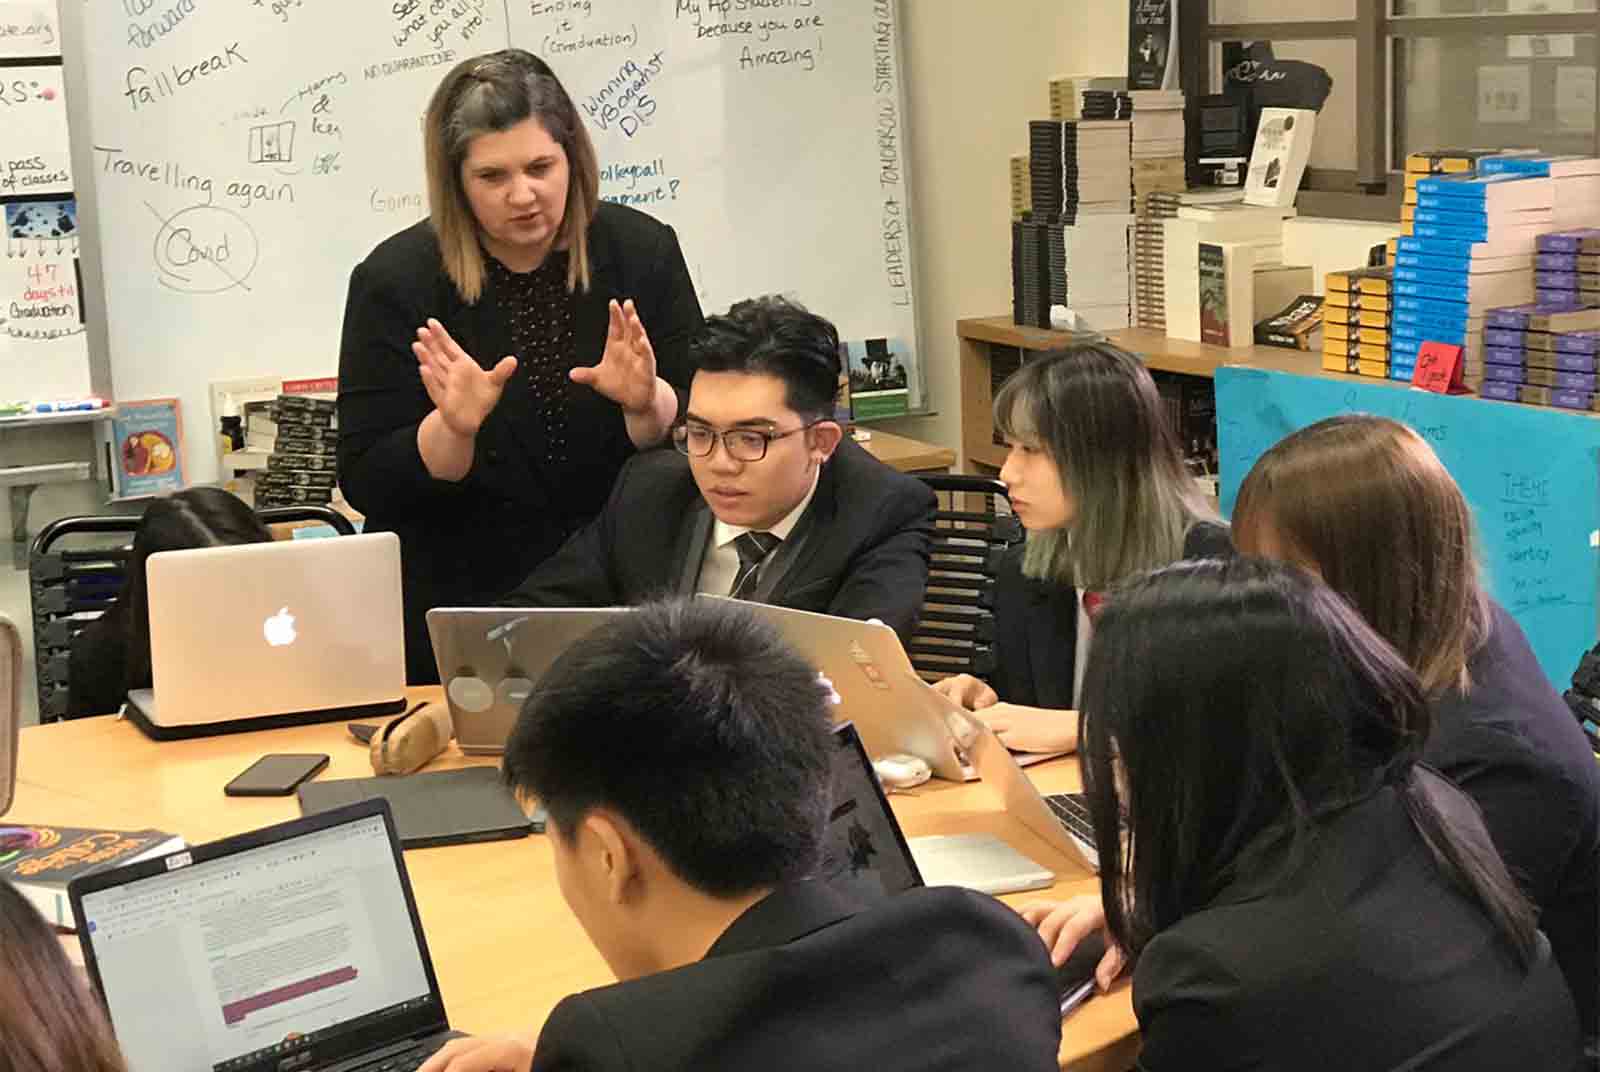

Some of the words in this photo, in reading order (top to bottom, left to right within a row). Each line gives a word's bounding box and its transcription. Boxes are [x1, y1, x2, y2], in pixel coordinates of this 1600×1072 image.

[696, 20, 753, 38] because
[758, 20, 788, 41] you
[794, 15, 824, 29] are
[739, 36, 823, 71] Amazing!
[9, 156, 46, 178] pass
[92, 144, 214, 207] Travelling
[226, 181, 295, 208] again
[2, 176, 17, 191] of
[22, 171, 69, 187] classes
[27, 264, 57, 284] 47
